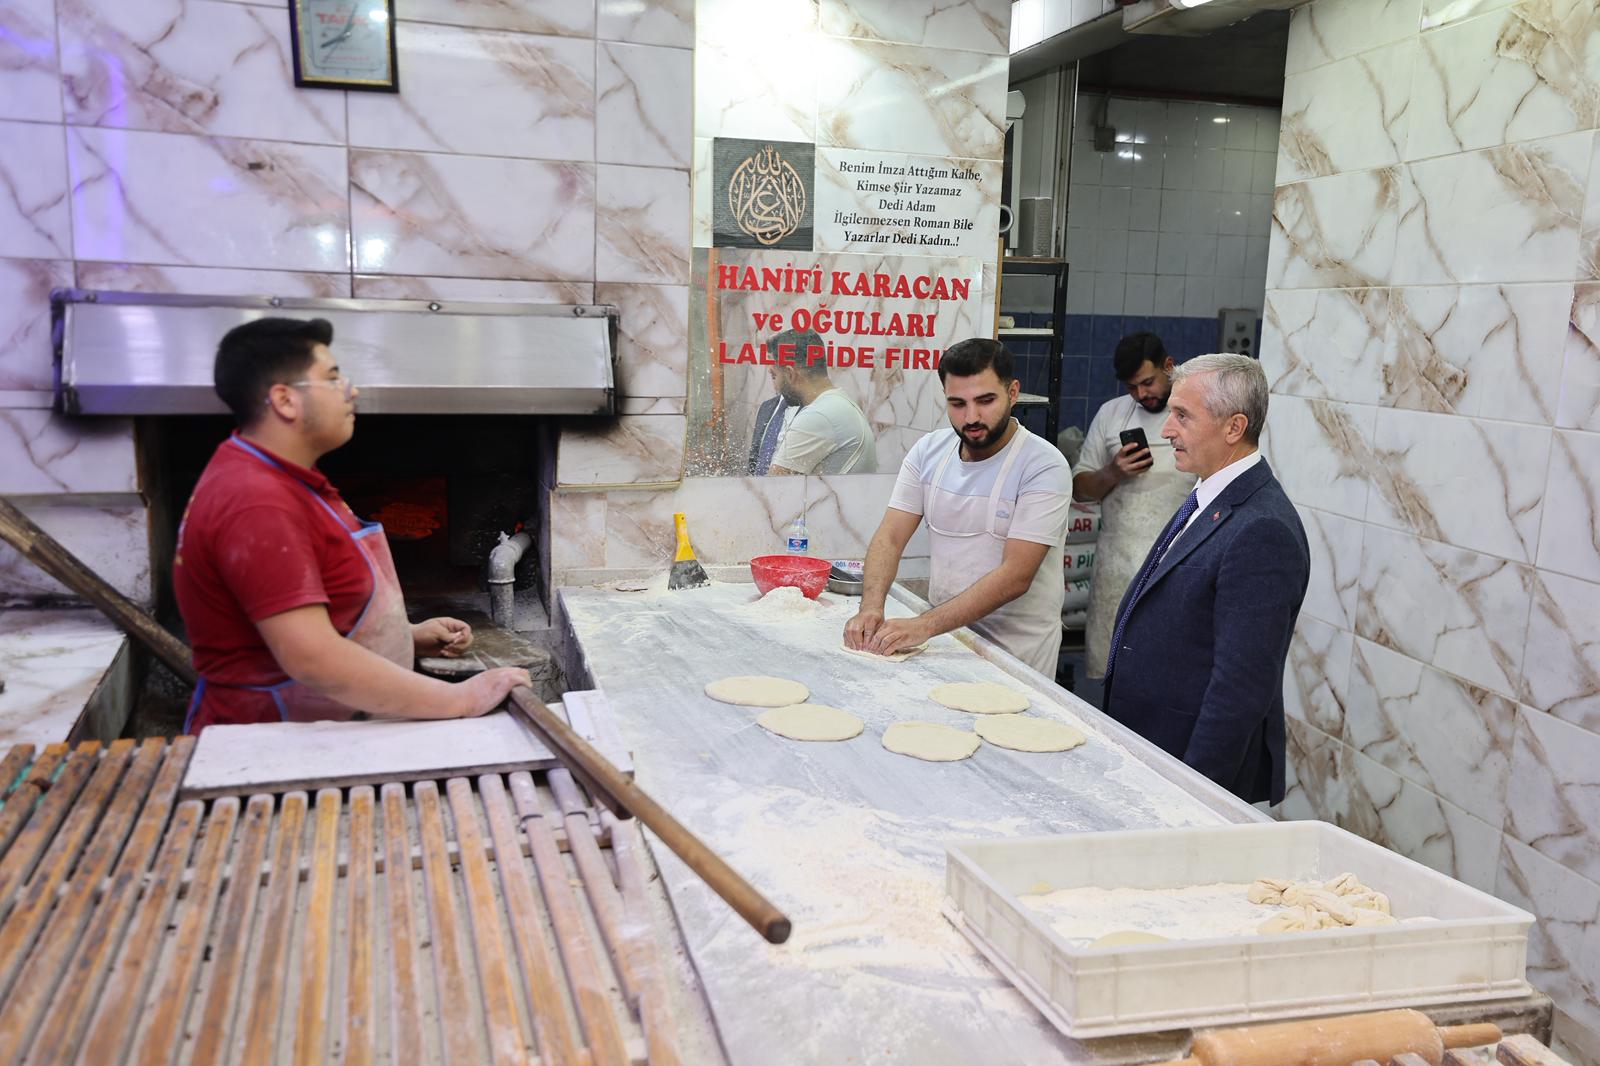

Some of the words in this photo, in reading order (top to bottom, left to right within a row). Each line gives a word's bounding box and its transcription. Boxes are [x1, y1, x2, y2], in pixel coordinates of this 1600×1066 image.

[839, 160, 875, 174] Benim
[878, 160, 905, 176] İmza
[907, 165, 948, 180] Attığım
[951, 167, 983, 183] Kalbe,
[856, 180, 891, 193] Kimse
[893, 181, 913, 196] Şiir
[915, 183, 962, 197] Yazamaz
[878, 199, 904, 211] Dedi
[906, 200, 936, 212] Adam
[834, 209, 911, 227] İlgilenmezsen
[913, 216, 950, 229] Roman
[953, 218, 974, 230] Bile
[844, 230, 891, 244] Yazarlar
[892, 232, 917, 245] Dedi
[919, 234, 960, 247] Kadın..!
[717, 262, 823, 294] HANİFİ
[831, 271, 971, 301] KARACAN
[752, 312, 784, 332] ve
[791, 303, 937, 337] OĞULLARI
[719, 342, 797, 367] LALE
[806, 340, 875, 369] PİDE
[885, 348, 946, 370] FIRI
[1068, 518, 1092, 532] AR
